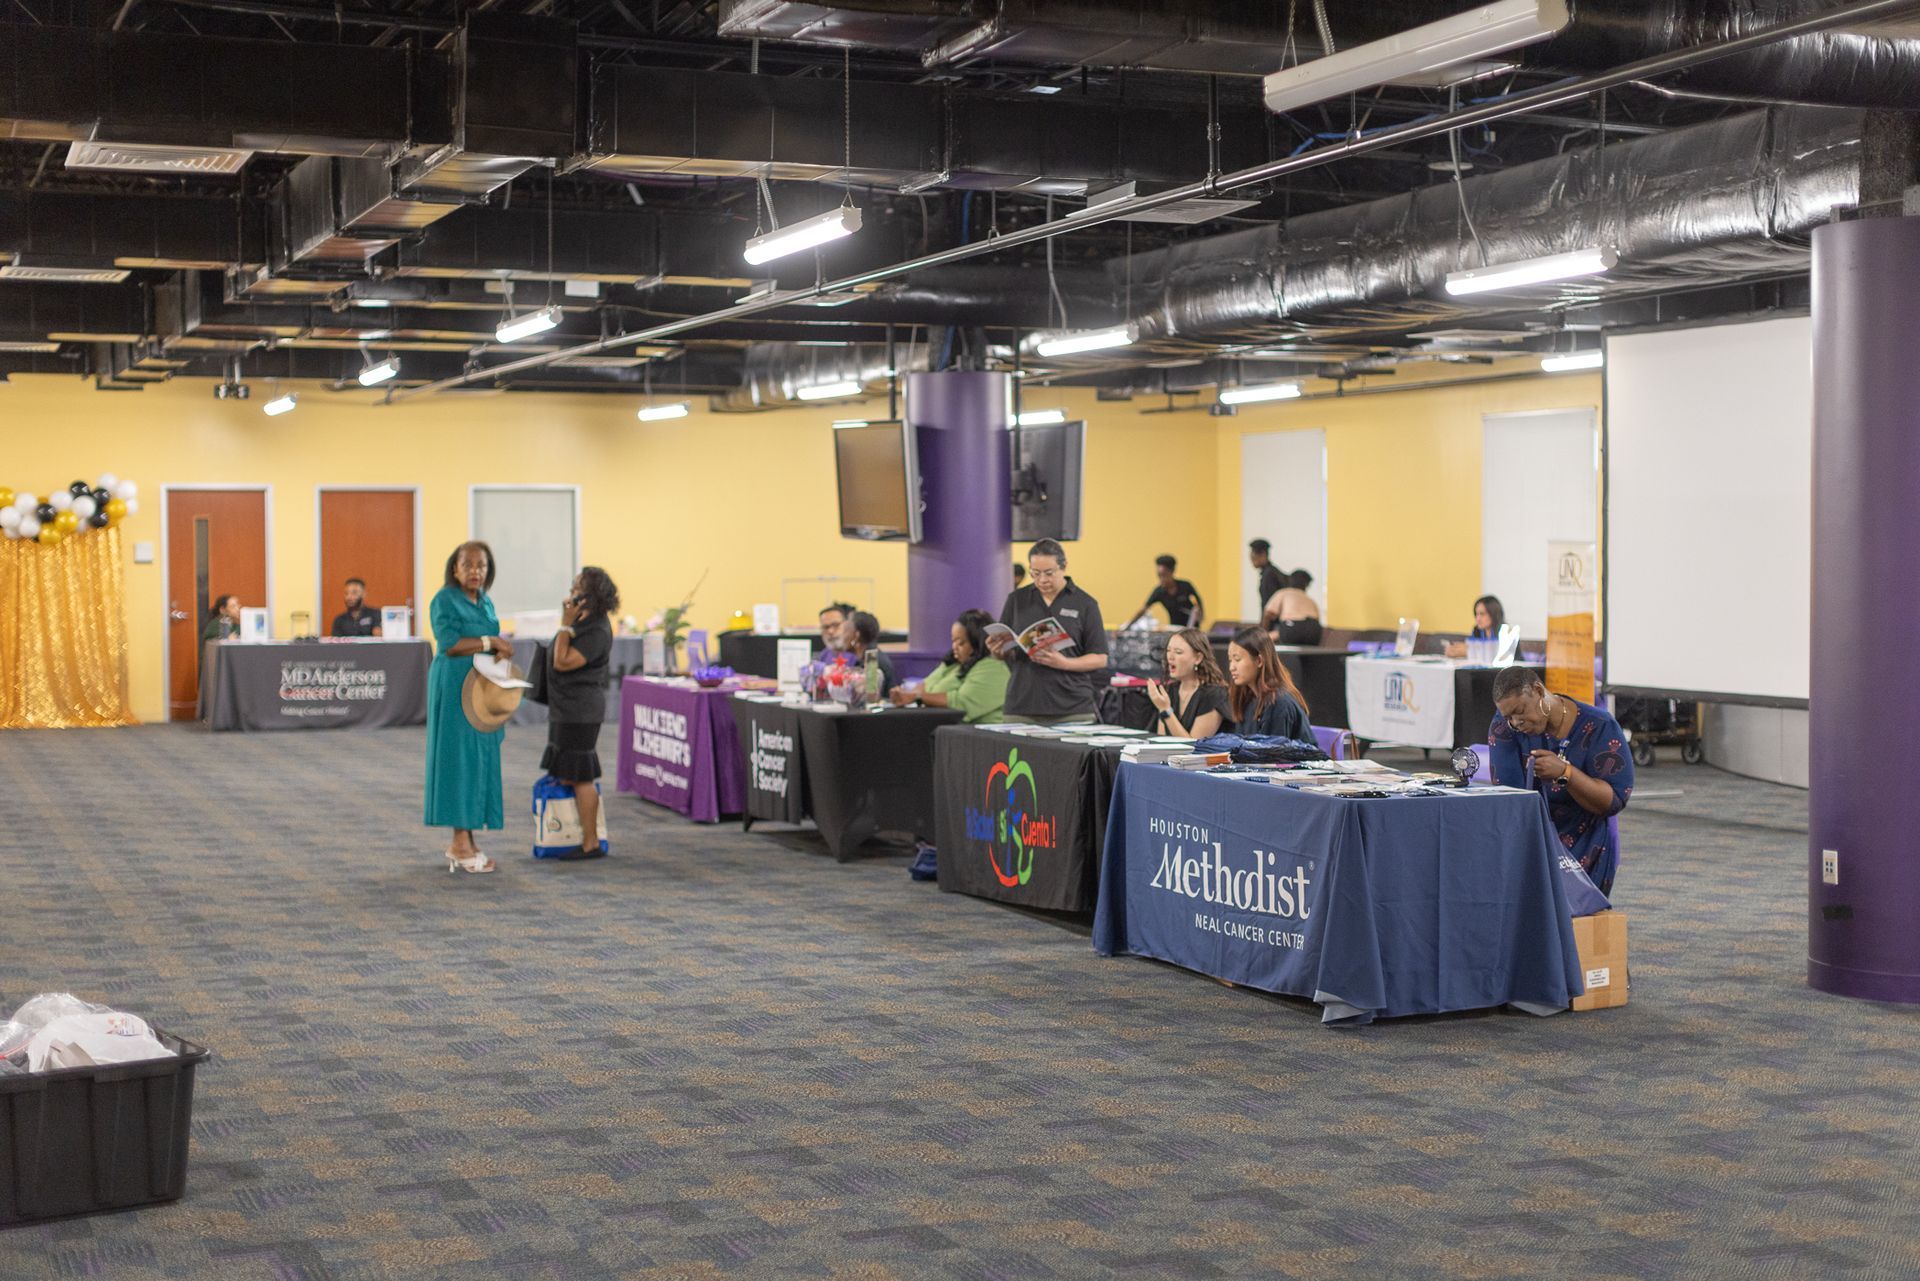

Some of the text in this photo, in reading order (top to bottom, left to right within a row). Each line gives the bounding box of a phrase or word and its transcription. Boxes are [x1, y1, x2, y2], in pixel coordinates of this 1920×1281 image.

[279, 683, 387, 700] Cancer Center
[758, 728, 793, 752] American
[758, 749, 786, 772] Cancer
[759, 770, 788, 798] Society
[1150, 817, 1209, 844] HOUSTON
[1195, 913, 1305, 950] NEAL CANCER CENTER
